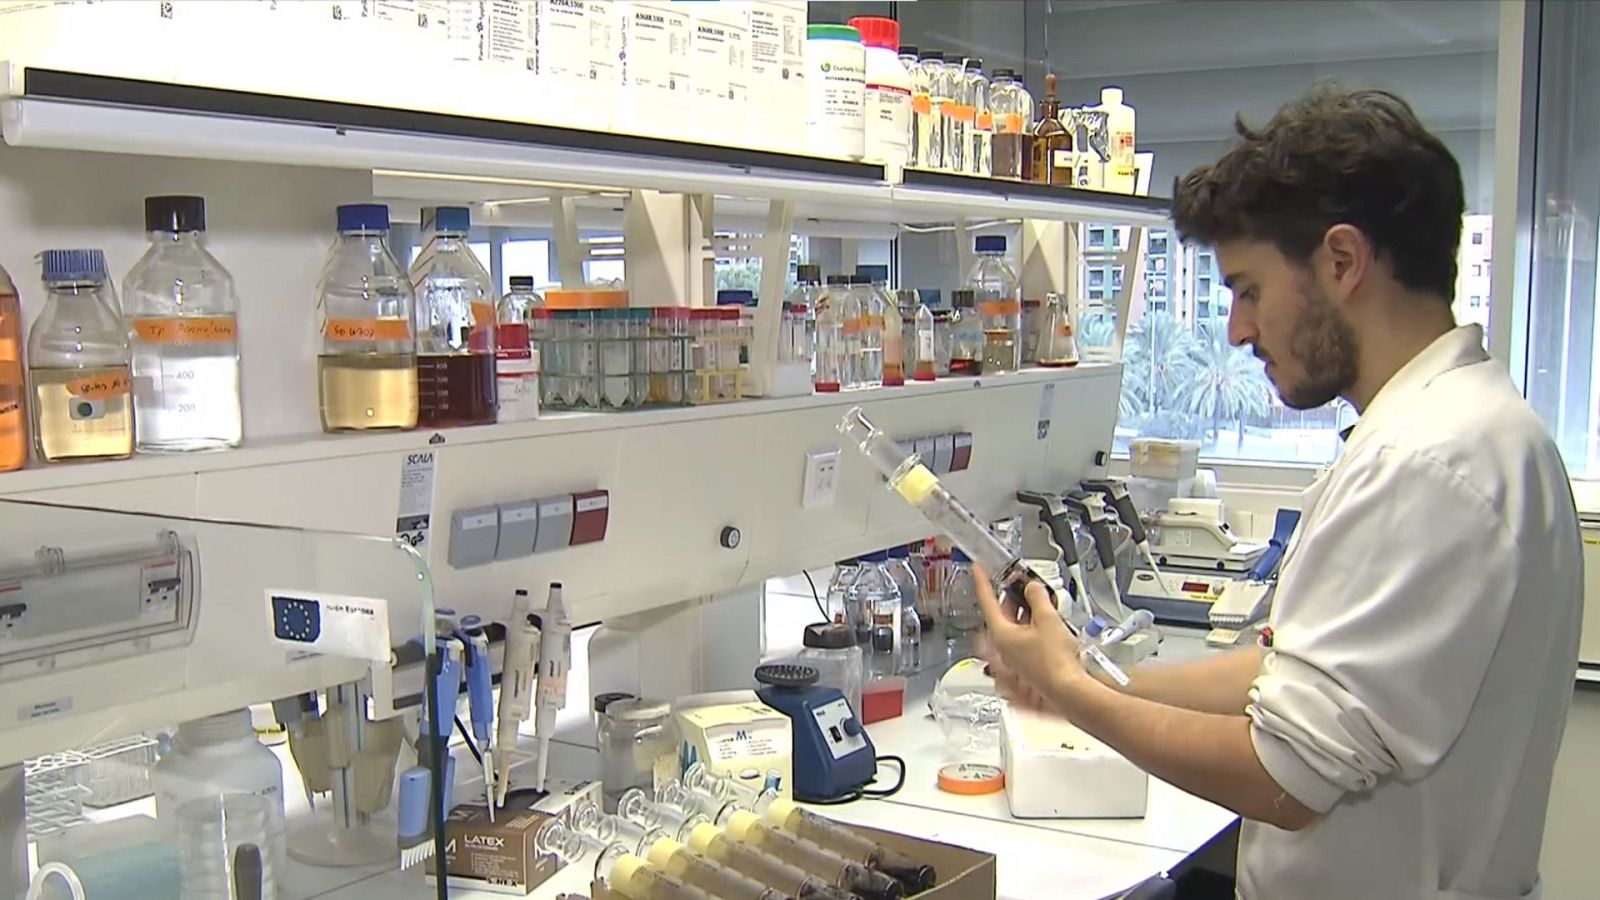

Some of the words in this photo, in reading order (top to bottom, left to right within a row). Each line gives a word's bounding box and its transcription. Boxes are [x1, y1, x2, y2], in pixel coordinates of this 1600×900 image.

[176, 371, 195, 380] 400
[177, 403, 196, 413] 200
[407, 453, 433, 465] SCALA
[464, 834, 505, 847] LATEX
